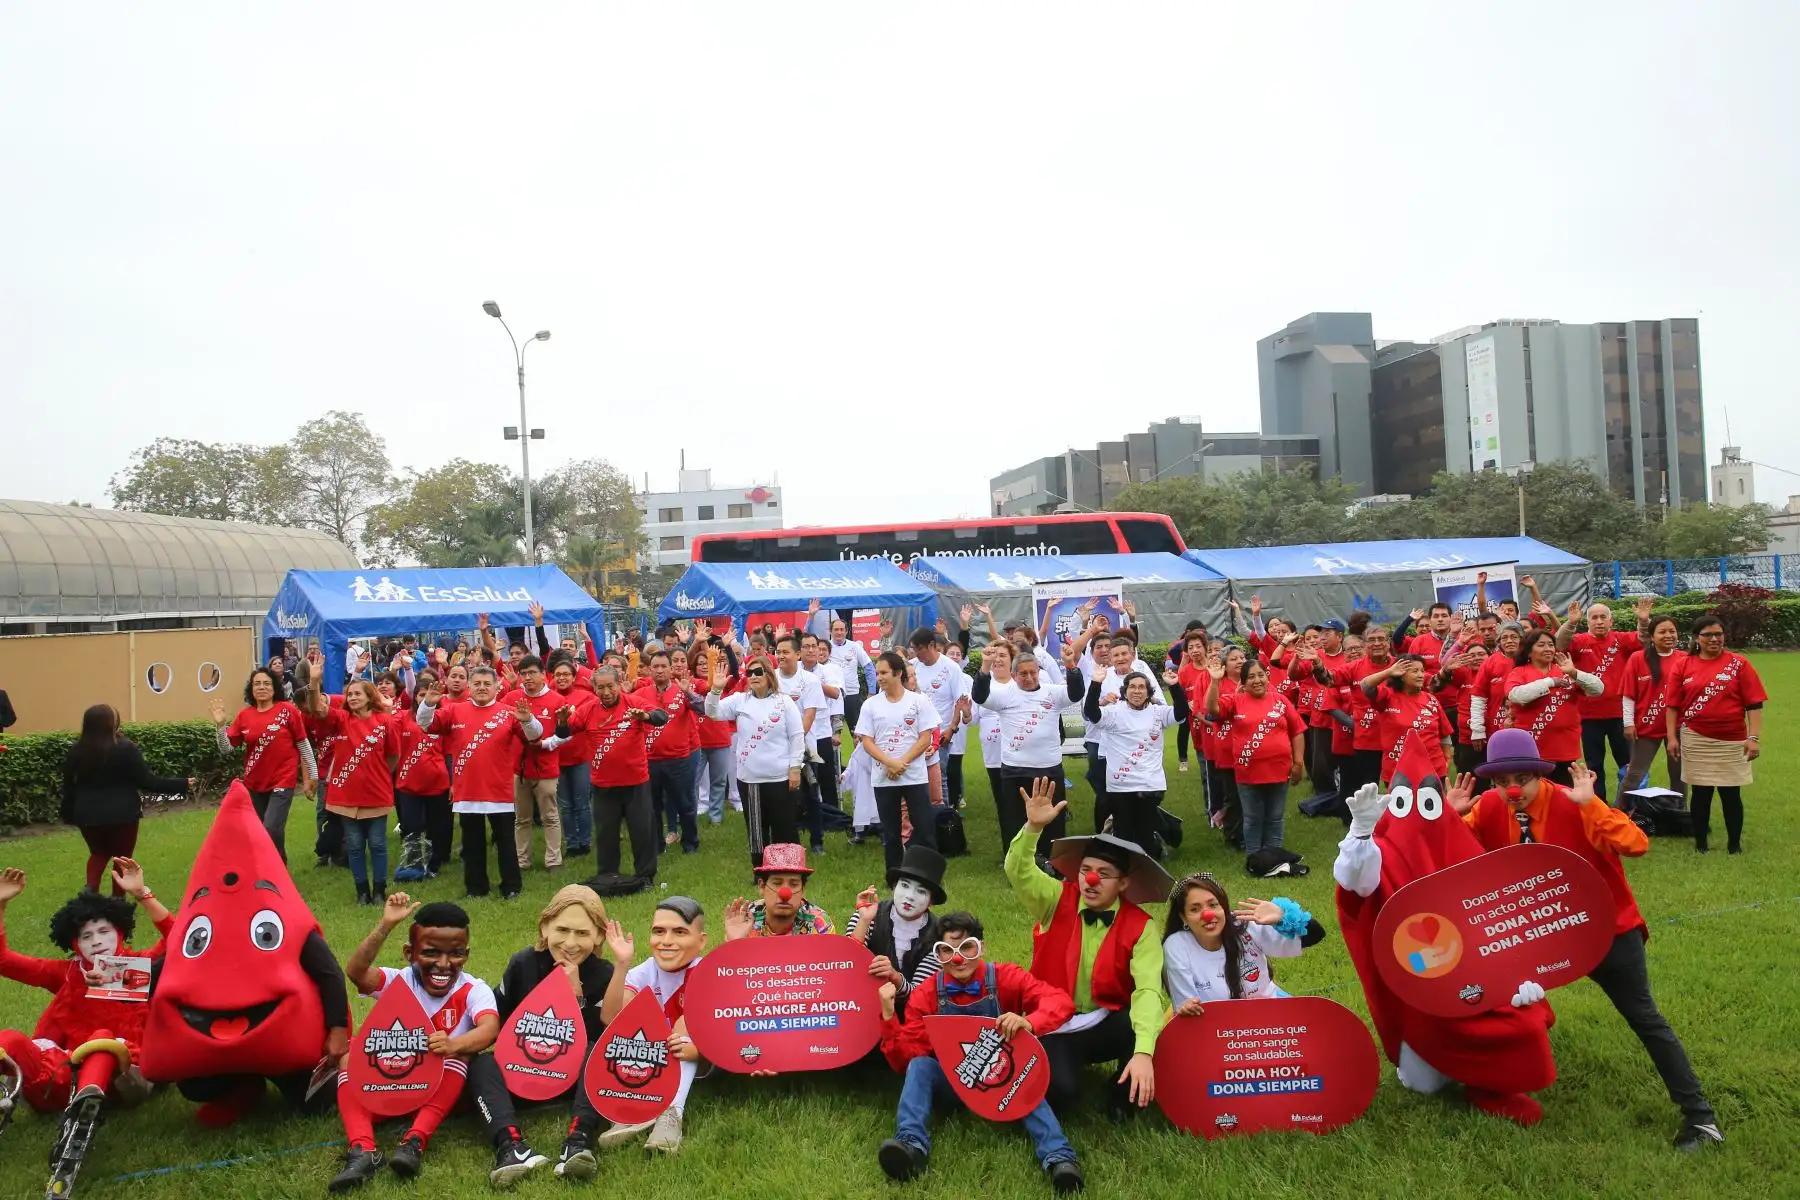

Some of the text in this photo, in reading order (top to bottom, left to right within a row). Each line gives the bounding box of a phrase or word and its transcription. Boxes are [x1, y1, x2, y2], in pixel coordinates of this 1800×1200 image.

[910, 547, 928, 564] al
[795, 576, 882, 590] EsSalud
[417, 586, 532, 602] EsSalud
[690, 597, 715, 610] EsSalud
[1462, 868, 1563, 910] Donar sangre es
[1468, 882, 1570, 925] un acto de amor
[1484, 901, 1570, 937] DONA HOY,
[1478, 911, 1590, 957] DONA SIEMPRE
[717, 960, 854, 977] No esperes que ocurran
[746, 976, 826, 989] los desastres.
[751, 988, 822, 1004] ¿Qué hacer?
[714, 1000, 861, 1019] DONA SANGRE AHORA,
[523, 1011, 574, 1028] HINCHAS DE
[740, 1016, 836, 1031] DONA SIEMPRE
[370, 1027, 425, 1038] HINCHAS DE
[515, 1018, 576, 1043] SANGRE
[1217, 1025, 1307, 1039] Las personas que
[364, 1036, 429, 1053] SANGRE
[613, 1035, 667, 1050] HINCHAS DE
[955, 1026, 991, 1075] HINCHAS DE
[1227, 1038, 1298, 1049] donan sangre
[605, 1043, 668, 1065] SANGRE
[960, 1028, 1005, 1088] SANGRE
[1223, 1049, 1304, 1062] son saludables.
[1225, 1066, 1305, 1080] DONA HOY,
[1213, 1079, 1319, 1095] DONA SIEMPRE
